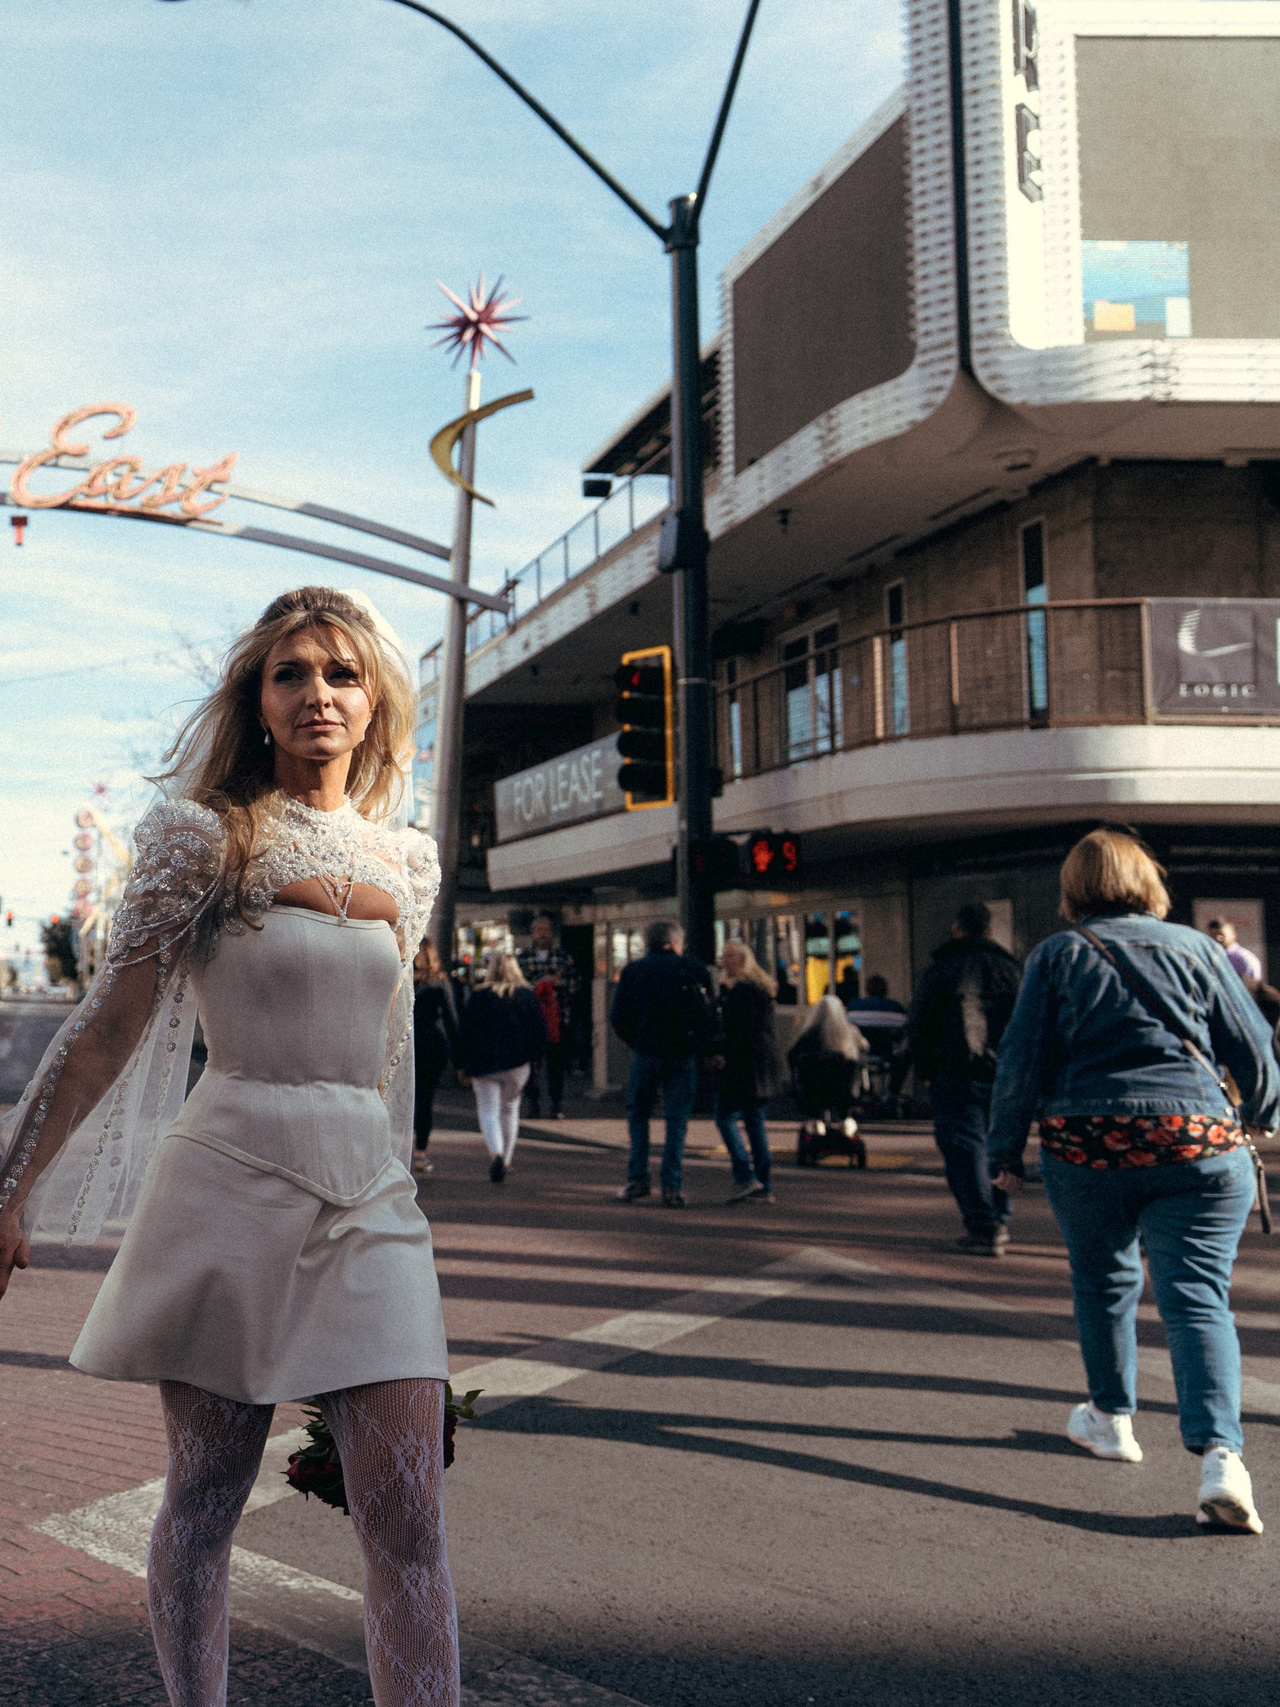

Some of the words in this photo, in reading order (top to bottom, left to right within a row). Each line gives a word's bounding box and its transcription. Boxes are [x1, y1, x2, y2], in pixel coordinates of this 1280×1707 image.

[10, 401, 239, 516] East
[1179, 683, 1257, 699] LOGIC
[513, 771, 547, 823] FOR
[549, 750, 603, 812] LEASE
[782, 841, 798, 872] 9
